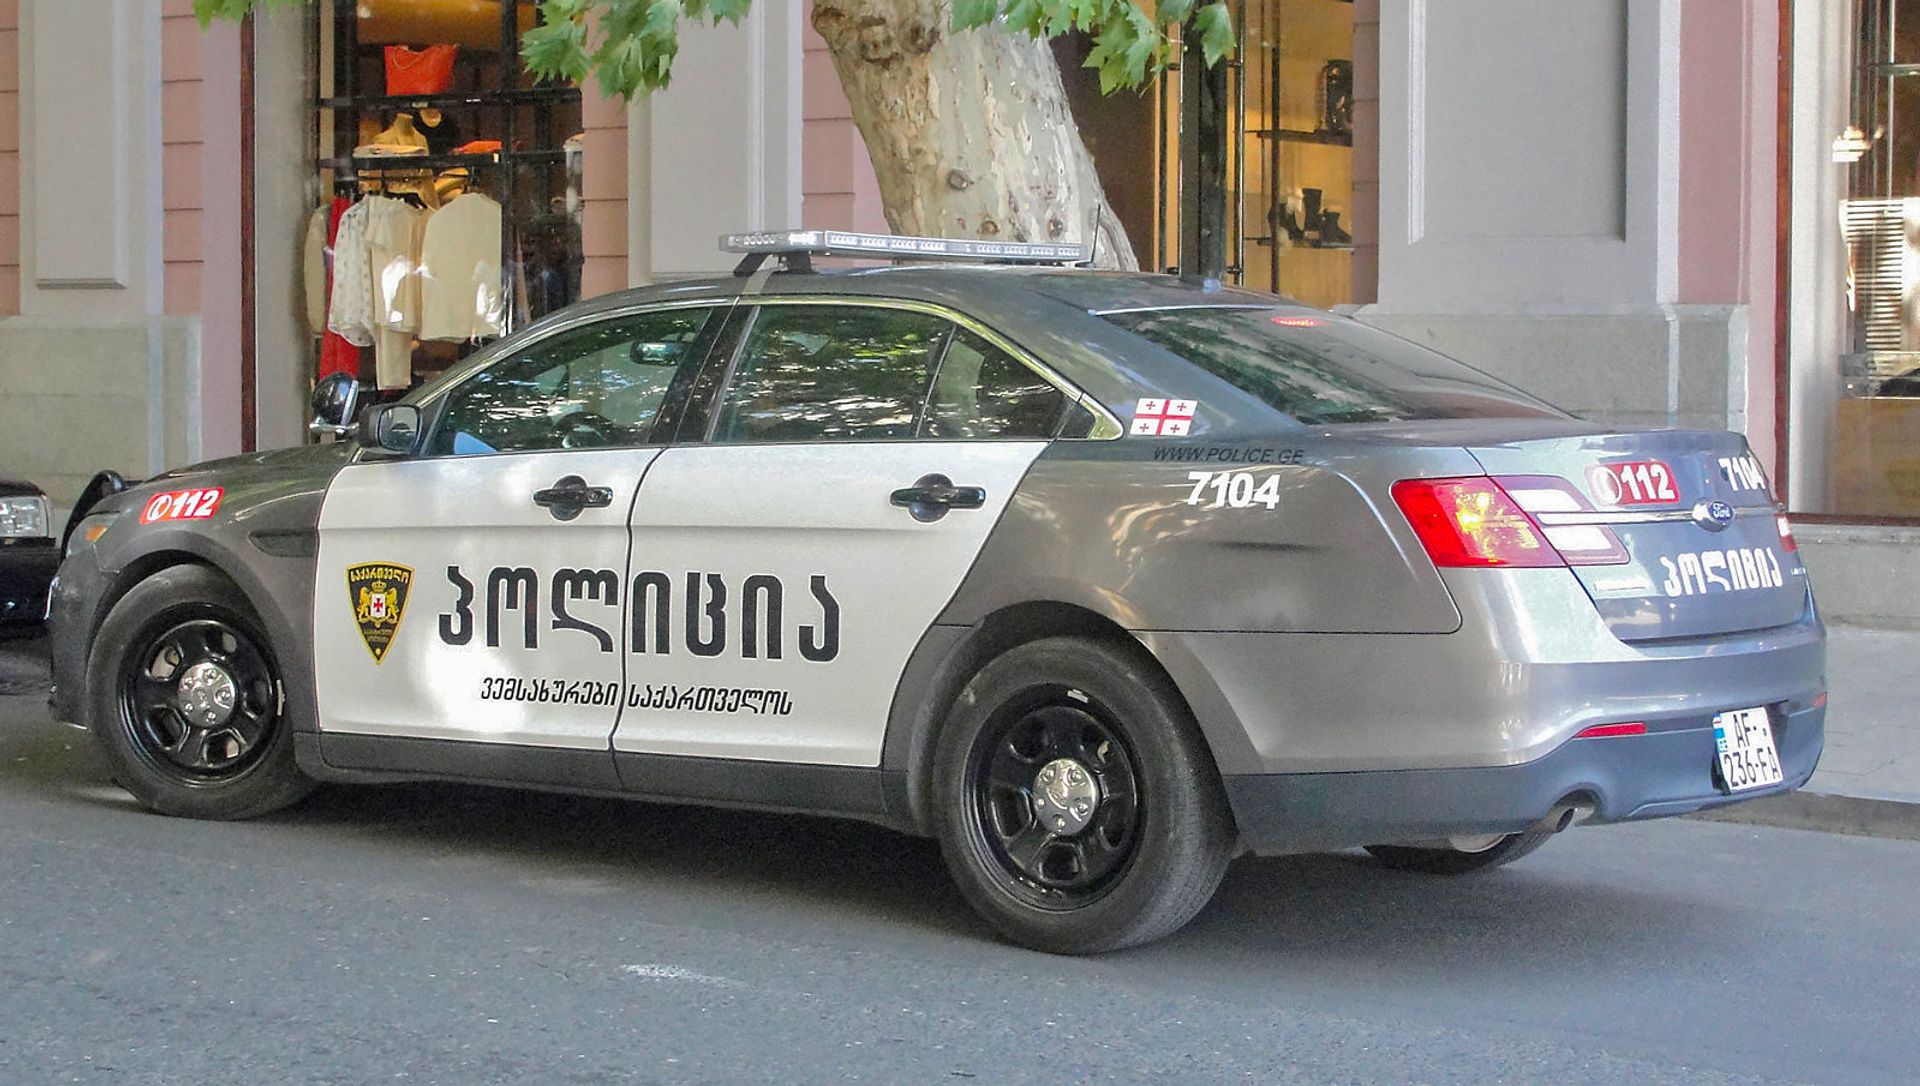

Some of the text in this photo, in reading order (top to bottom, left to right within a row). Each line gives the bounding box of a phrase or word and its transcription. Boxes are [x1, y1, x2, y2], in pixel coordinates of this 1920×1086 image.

[1153, 447, 1306, 464] WWW.POLICE.GE
[1187, 471, 1281, 510] 7104
[1621, 464, 1676, 500] 112
[170, 490, 220, 518] 112
[1660, 547, 1783, 597] პოლიცია
[438, 565, 841, 663] პოლიცია
[481, 677, 793, 715] ვემსახურები საქართველოს
